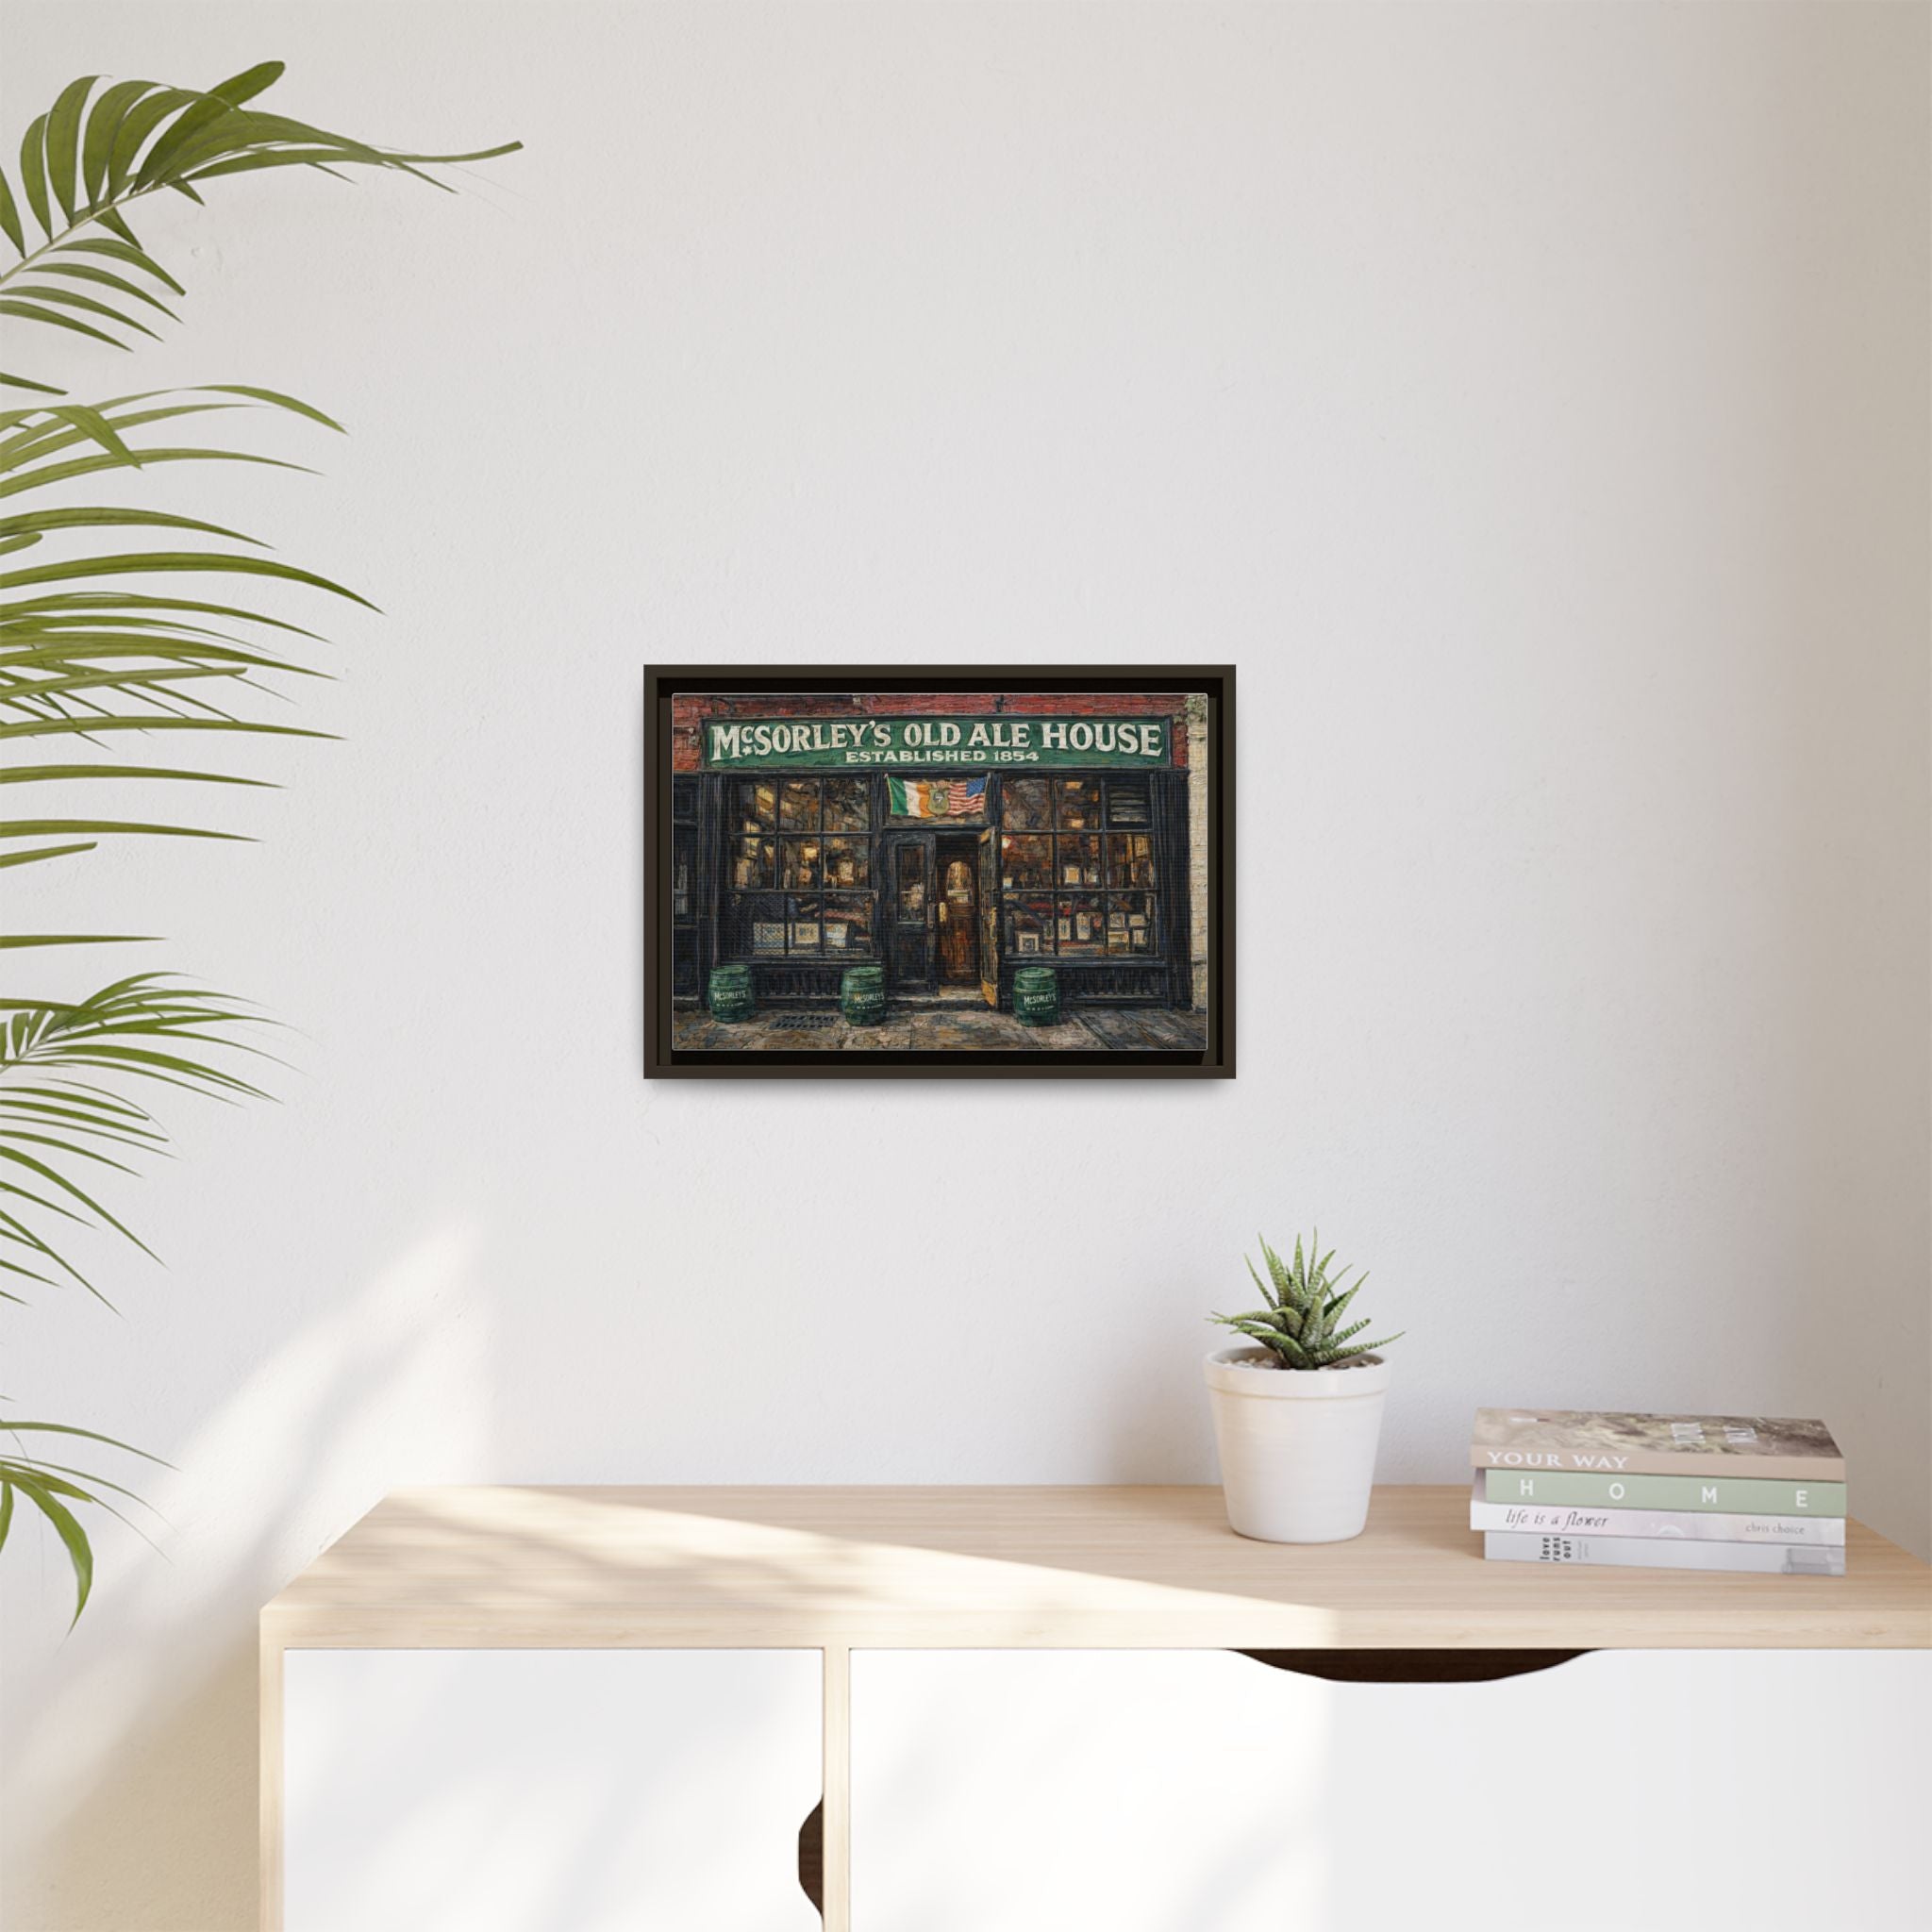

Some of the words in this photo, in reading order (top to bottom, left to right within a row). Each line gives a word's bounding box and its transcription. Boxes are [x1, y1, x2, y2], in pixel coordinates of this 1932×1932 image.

[904, 723, 961, 748] OLD
[967, 723, 1031, 748] ALE
[1041, 722, 1163, 757] HOUSE
[845, 750, 987, 763] ESTABLISHED
[994, 750, 1040, 762] 1854
[1487, 1451, 1563, 1467] YOUR
[1573, 1454, 1629, 1469] WAY
[1506, 1509, 1528, 1529] life
[1534, 1512, 1546, 1524] is
[1550, 1516, 1559, 1524] a
[1561, 1510, 1608, 1531] flower
[1745, 1522, 1770, 1534] chris
[1772, 1522, 1806, 1535] choice
[1539, 1537, 1550, 1560] love
[1553, 1537, 1561, 1561] runs
[1562, 1540, 1572, 1558] out
